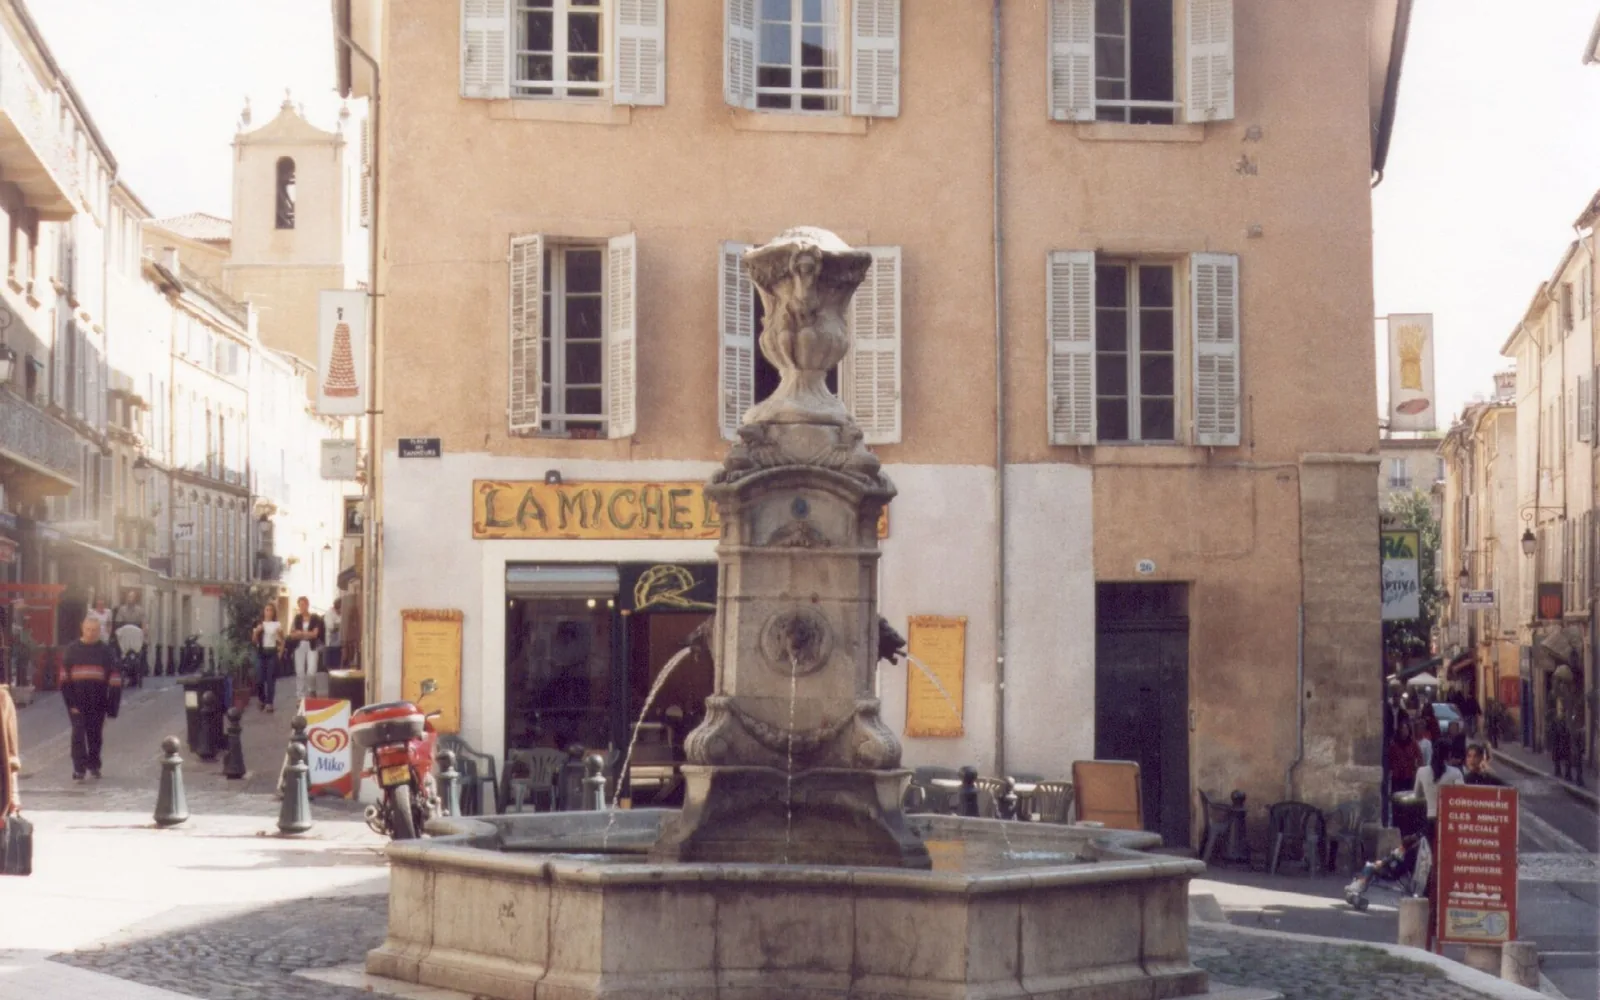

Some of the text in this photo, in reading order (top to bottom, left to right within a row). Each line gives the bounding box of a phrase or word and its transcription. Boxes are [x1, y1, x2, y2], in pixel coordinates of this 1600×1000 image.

[484, 484, 720, 531] LA MICHEL
[315, 757, 345, 772] Miko
[1449, 797, 1509, 809] CORDONNERIE
[1477, 813, 1509, 824] MINUTE
[1458, 823, 1499, 834] SPECIALE
[1457, 836, 1500, 847] TAMPONS
[1456, 850, 1501, 862] GRAVURES
[1453, 864, 1503, 875] IMPRIMERIE
